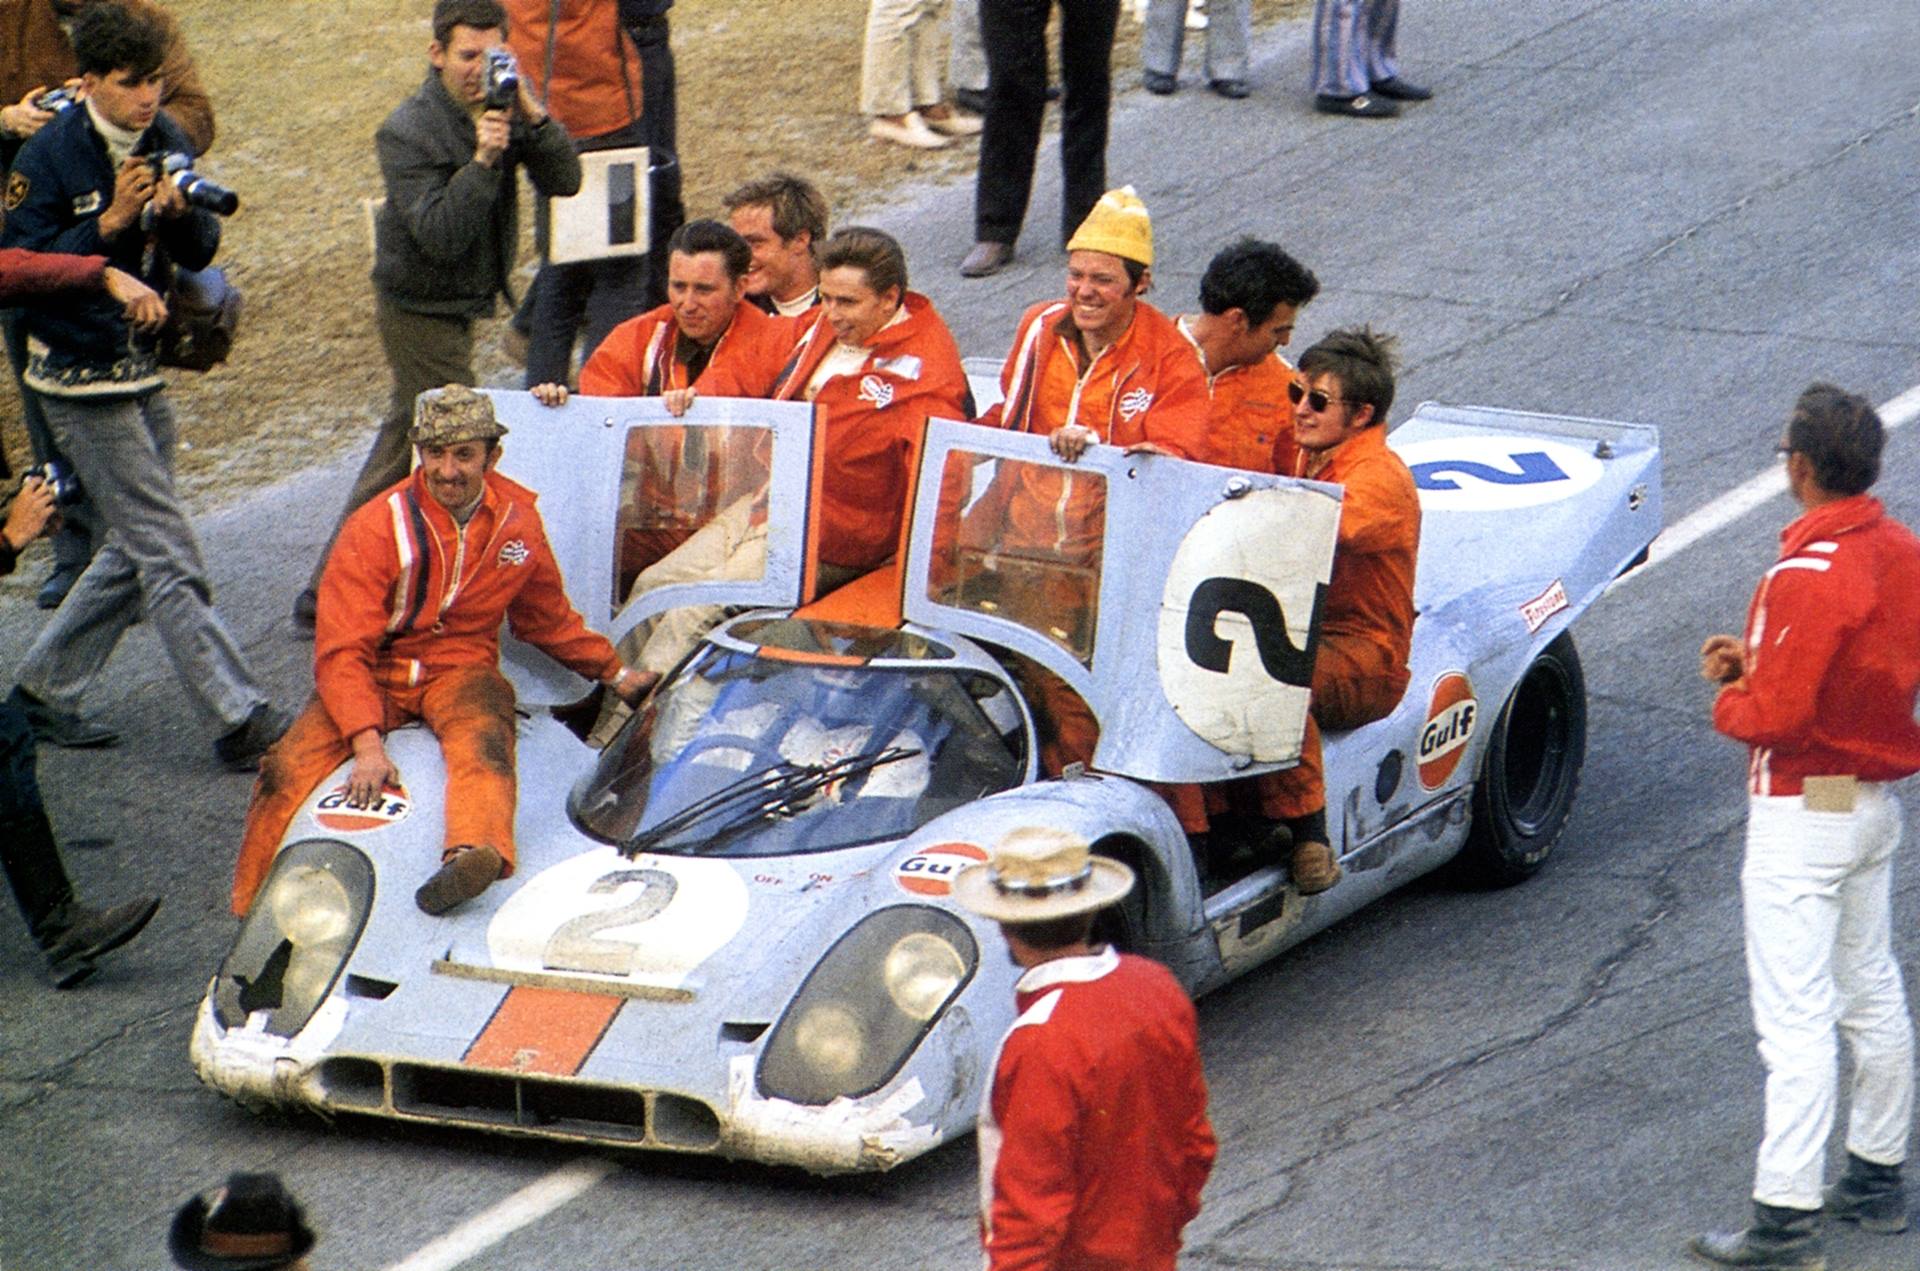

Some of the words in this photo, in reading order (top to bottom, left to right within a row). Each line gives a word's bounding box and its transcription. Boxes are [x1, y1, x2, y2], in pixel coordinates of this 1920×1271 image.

[1408, 451, 1571, 491] 2
[1184, 576, 1330, 689] 2
[1420, 705, 1475, 757] Gulf
[754, 873, 784, 886] OFF
[808, 871, 833, 883] ON
[541, 868, 679, 977] 2
